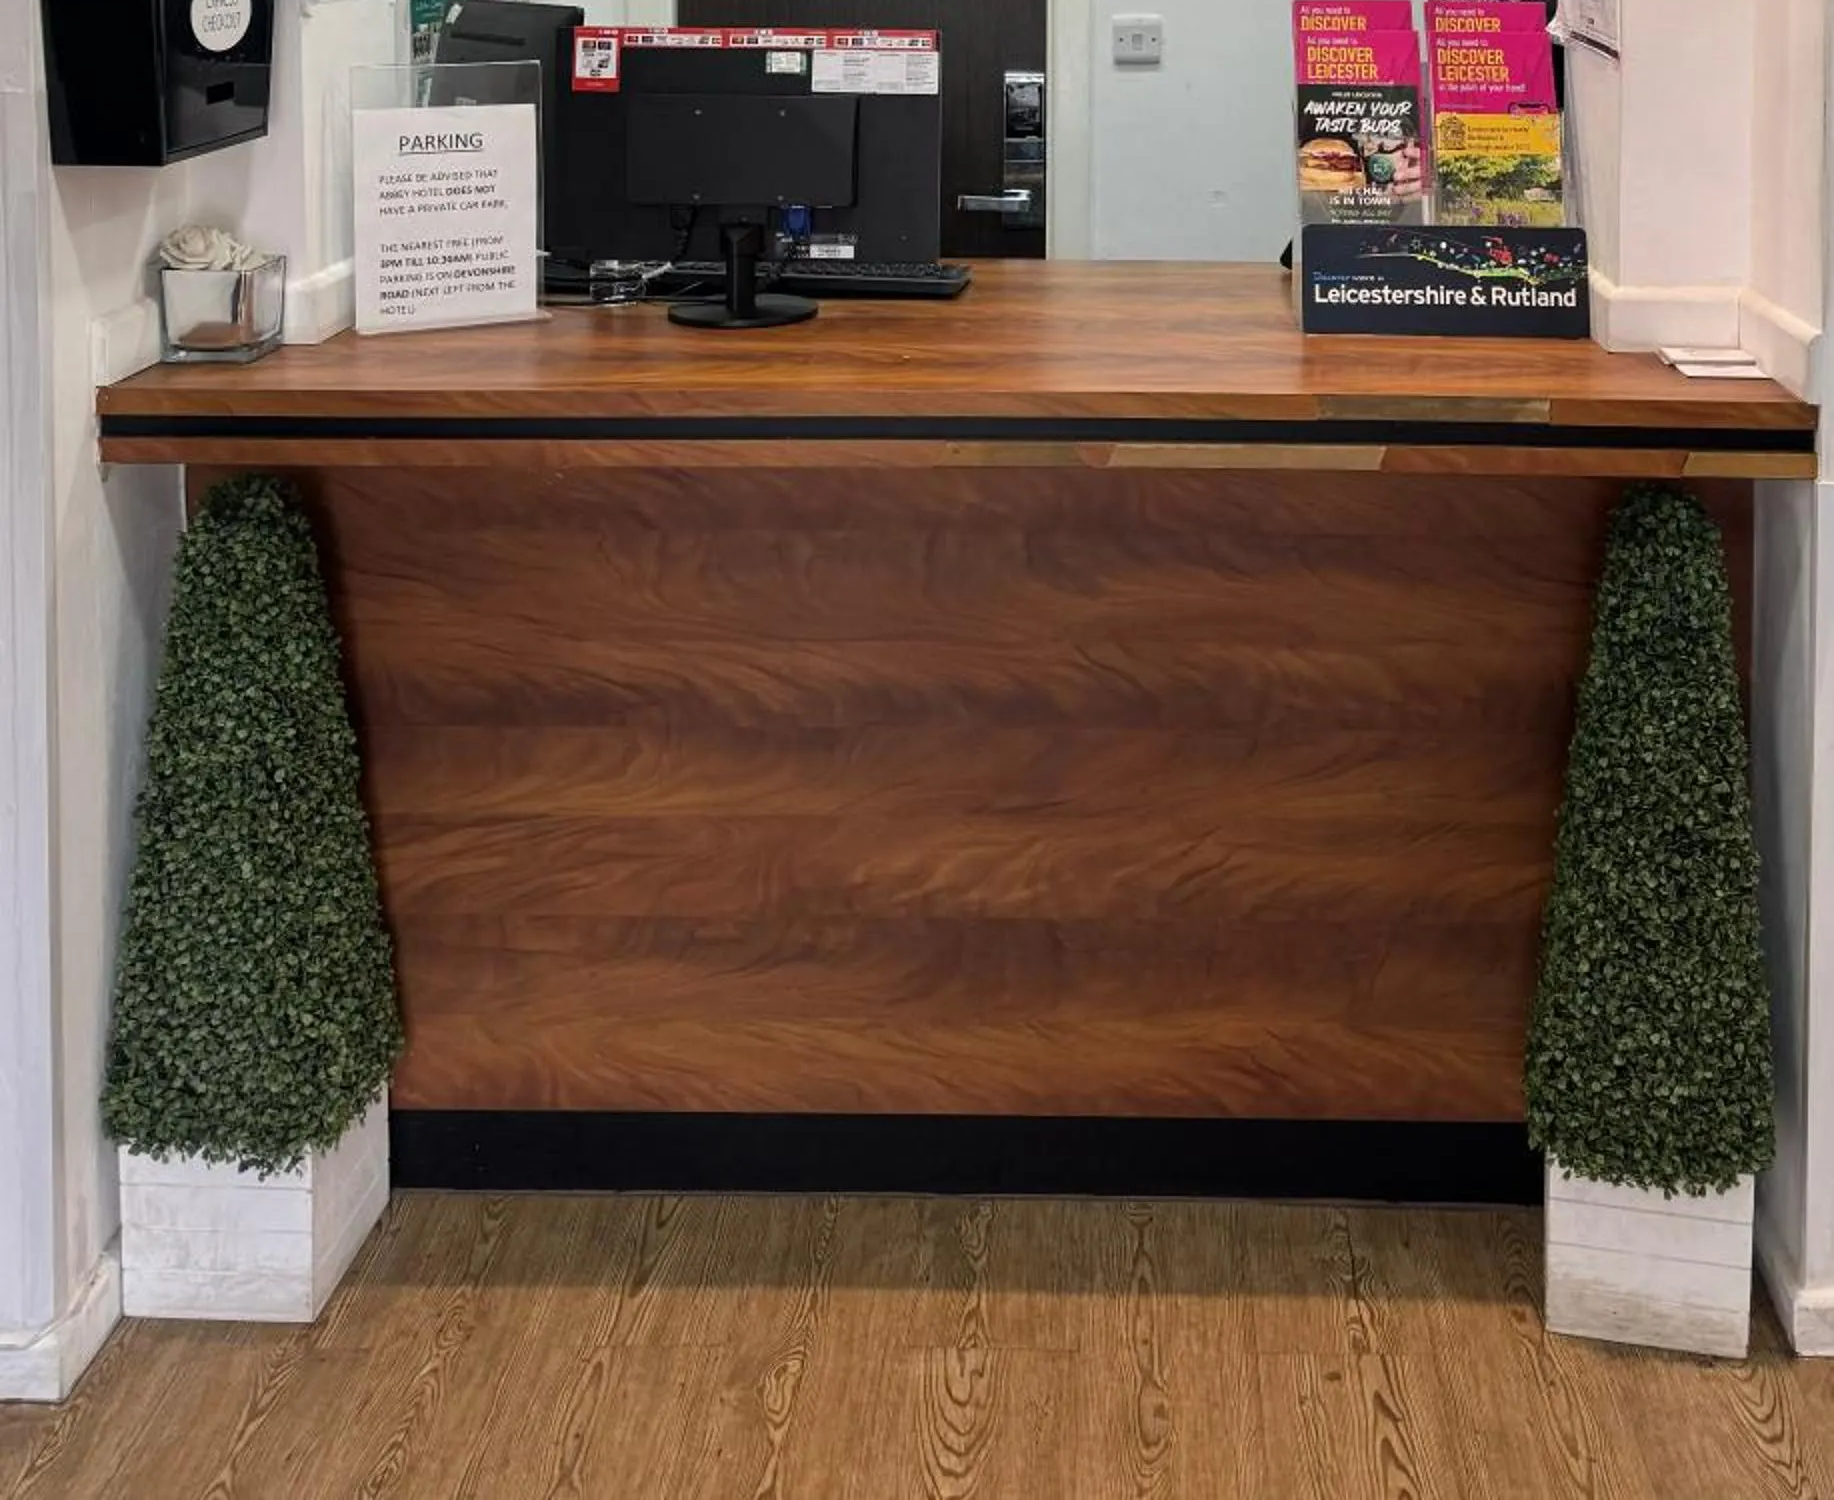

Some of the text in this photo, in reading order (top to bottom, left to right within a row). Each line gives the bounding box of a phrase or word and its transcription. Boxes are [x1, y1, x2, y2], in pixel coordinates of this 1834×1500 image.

[1300, 15, 1367, 31] DISCOVER
[1435, 17, 1501, 32] DISCOVER
[1307, 46, 1374, 63] DISCOVER
[1437, 48, 1505, 65] DISCOVER
[1307, 63, 1379, 80] LEICESTER
[1438, 65, 1510, 83] LEICESTER
[1303, 100, 1412, 116] AWAKEN YOUR
[1315, 118, 1402, 134] TASTE BUDS
[399, 132, 484, 152] PARKING
[379, 169, 498, 184] PLEASE BE ADVISED THAT
[379, 184, 497, 200] ABBEY HOTEL DOES NOT
[379, 206, 405, 217] HAVE
[407, 205, 416, 214] A
[417, 202, 457, 213] PRIVATE
[459, 200, 479, 211] CAR
[1343, 196, 1355, 205] IN
[1359, 196, 1391, 206] TOWN
[380, 242, 399, 253] THE
[401, 239, 445, 252] NEAREST
[404, 256, 425, 267] TILL
[475, 249, 511, 261] PUBLIC
[379, 265, 516, 285] PARKING IS ON DEVONSHIRE
[379, 288, 411, 300] ROAD
[443, 284, 464, 295] LEFT
[466, 281, 495, 293] FROM
[497, 279, 518, 290] THE
[1314, 284, 1577, 307] Leicestershire & Rutland
